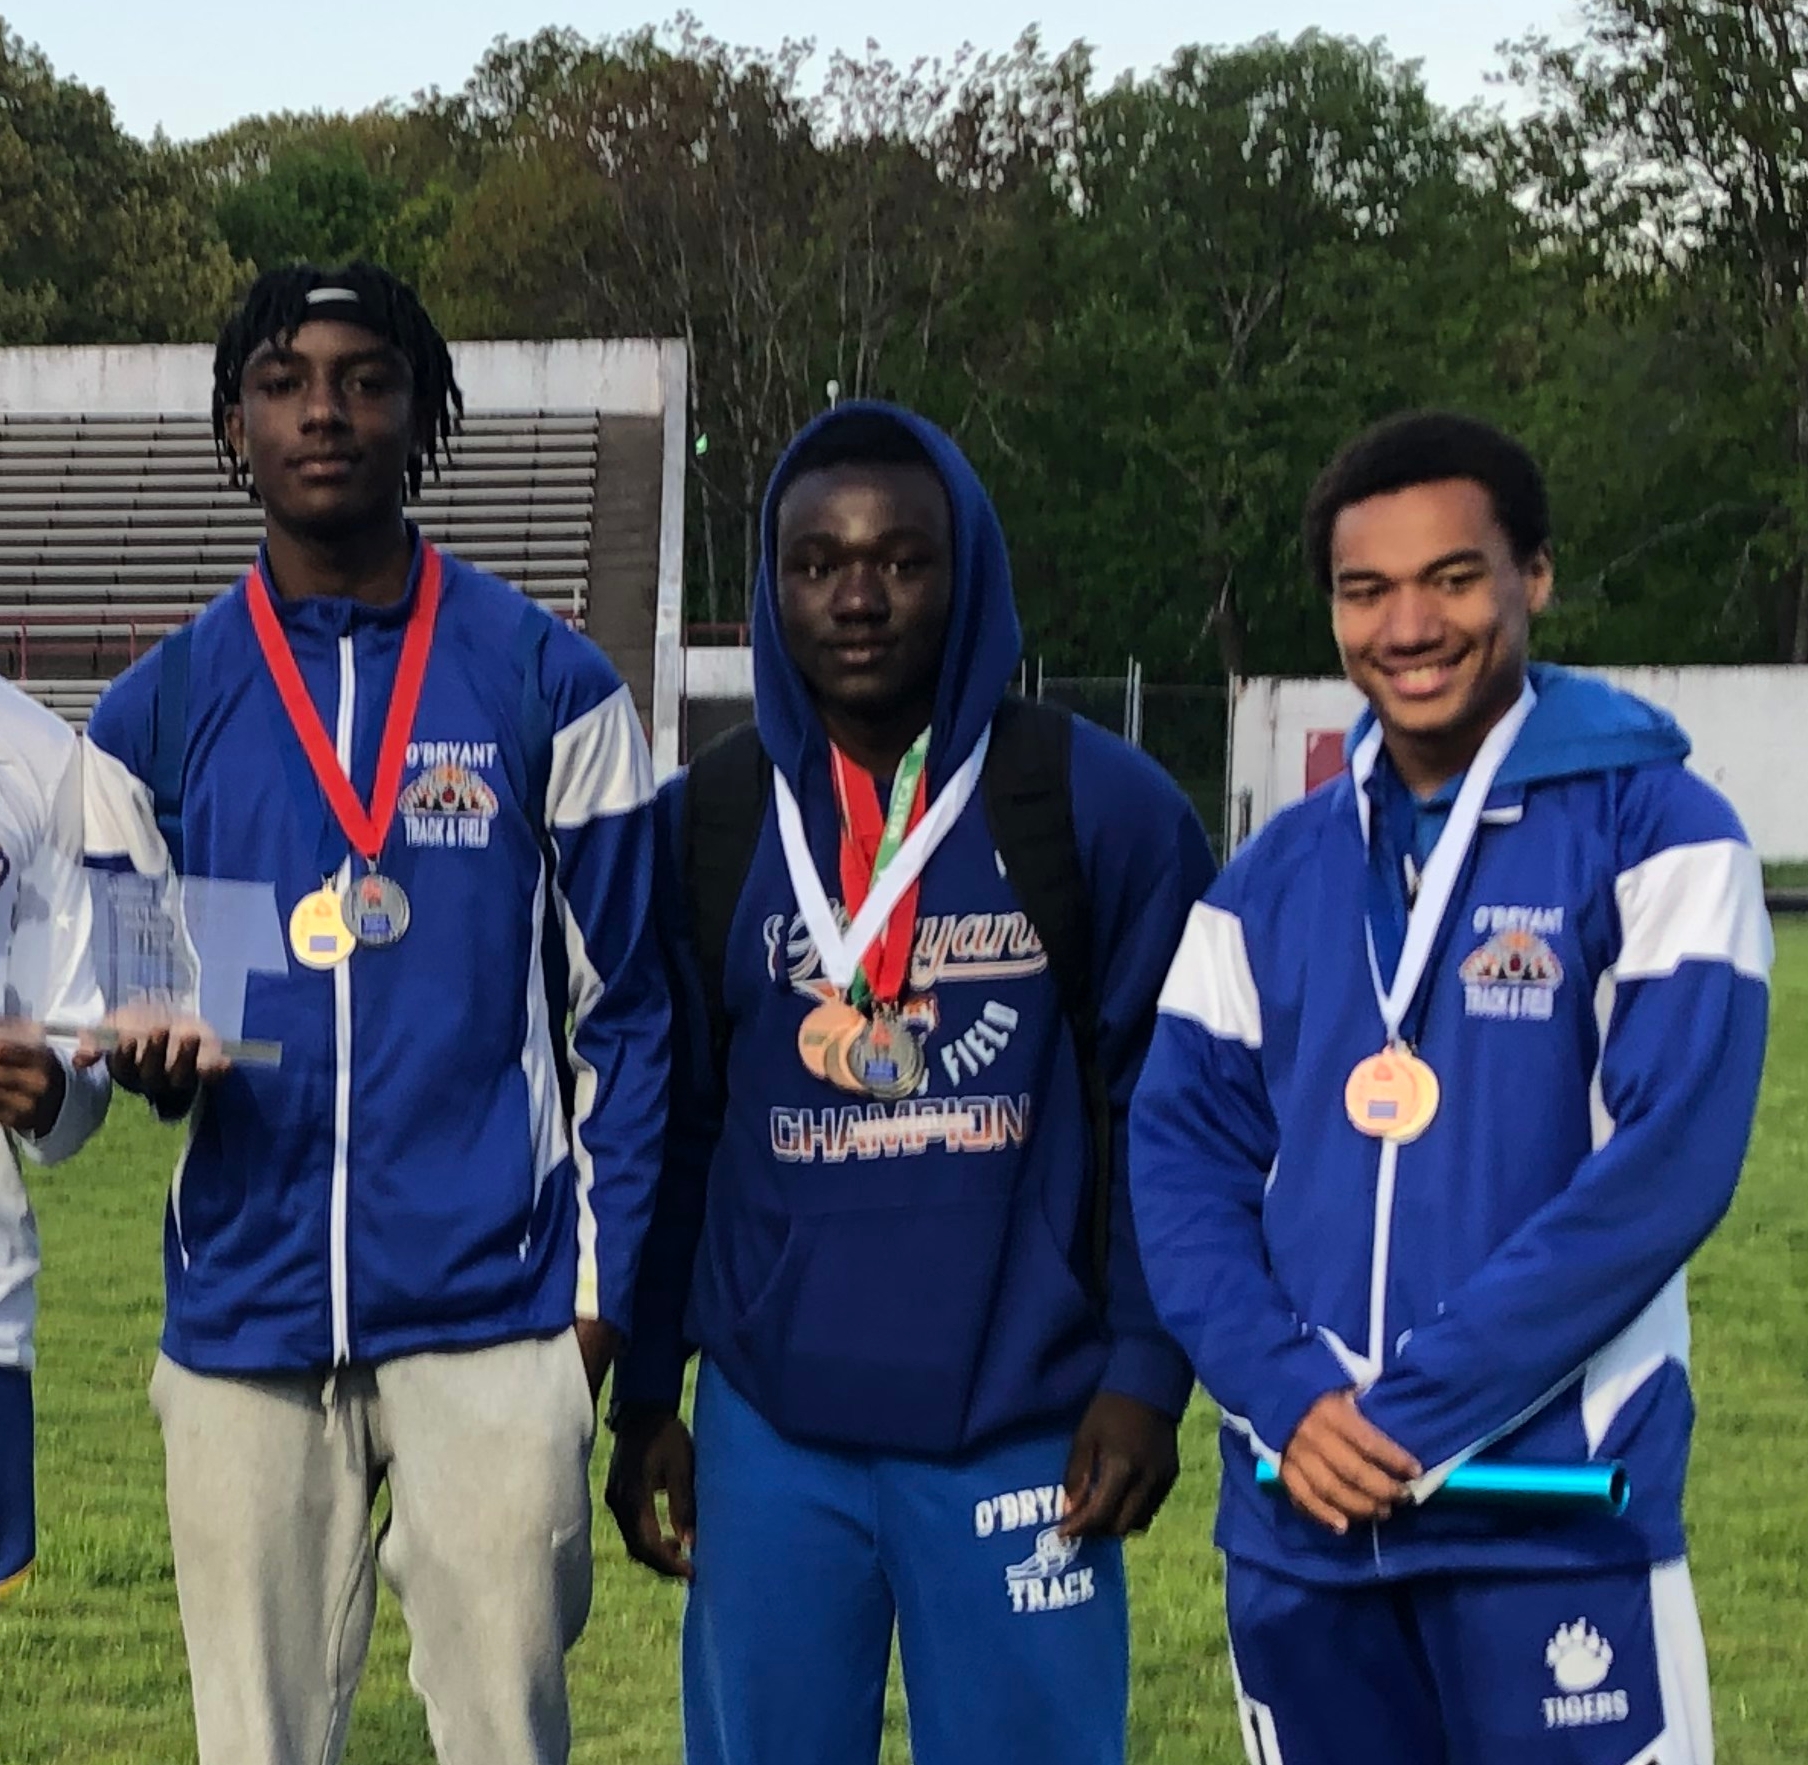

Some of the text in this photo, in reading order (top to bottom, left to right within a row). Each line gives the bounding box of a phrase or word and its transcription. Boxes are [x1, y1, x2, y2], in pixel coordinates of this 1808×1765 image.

[405, 740, 498, 769] O'BRYANT
[770, 1093, 1030, 1164] CHAMPION
[1006, 1566, 1095, 1613] TRACK
[1541, 1689, 1629, 1729] TIGERS
